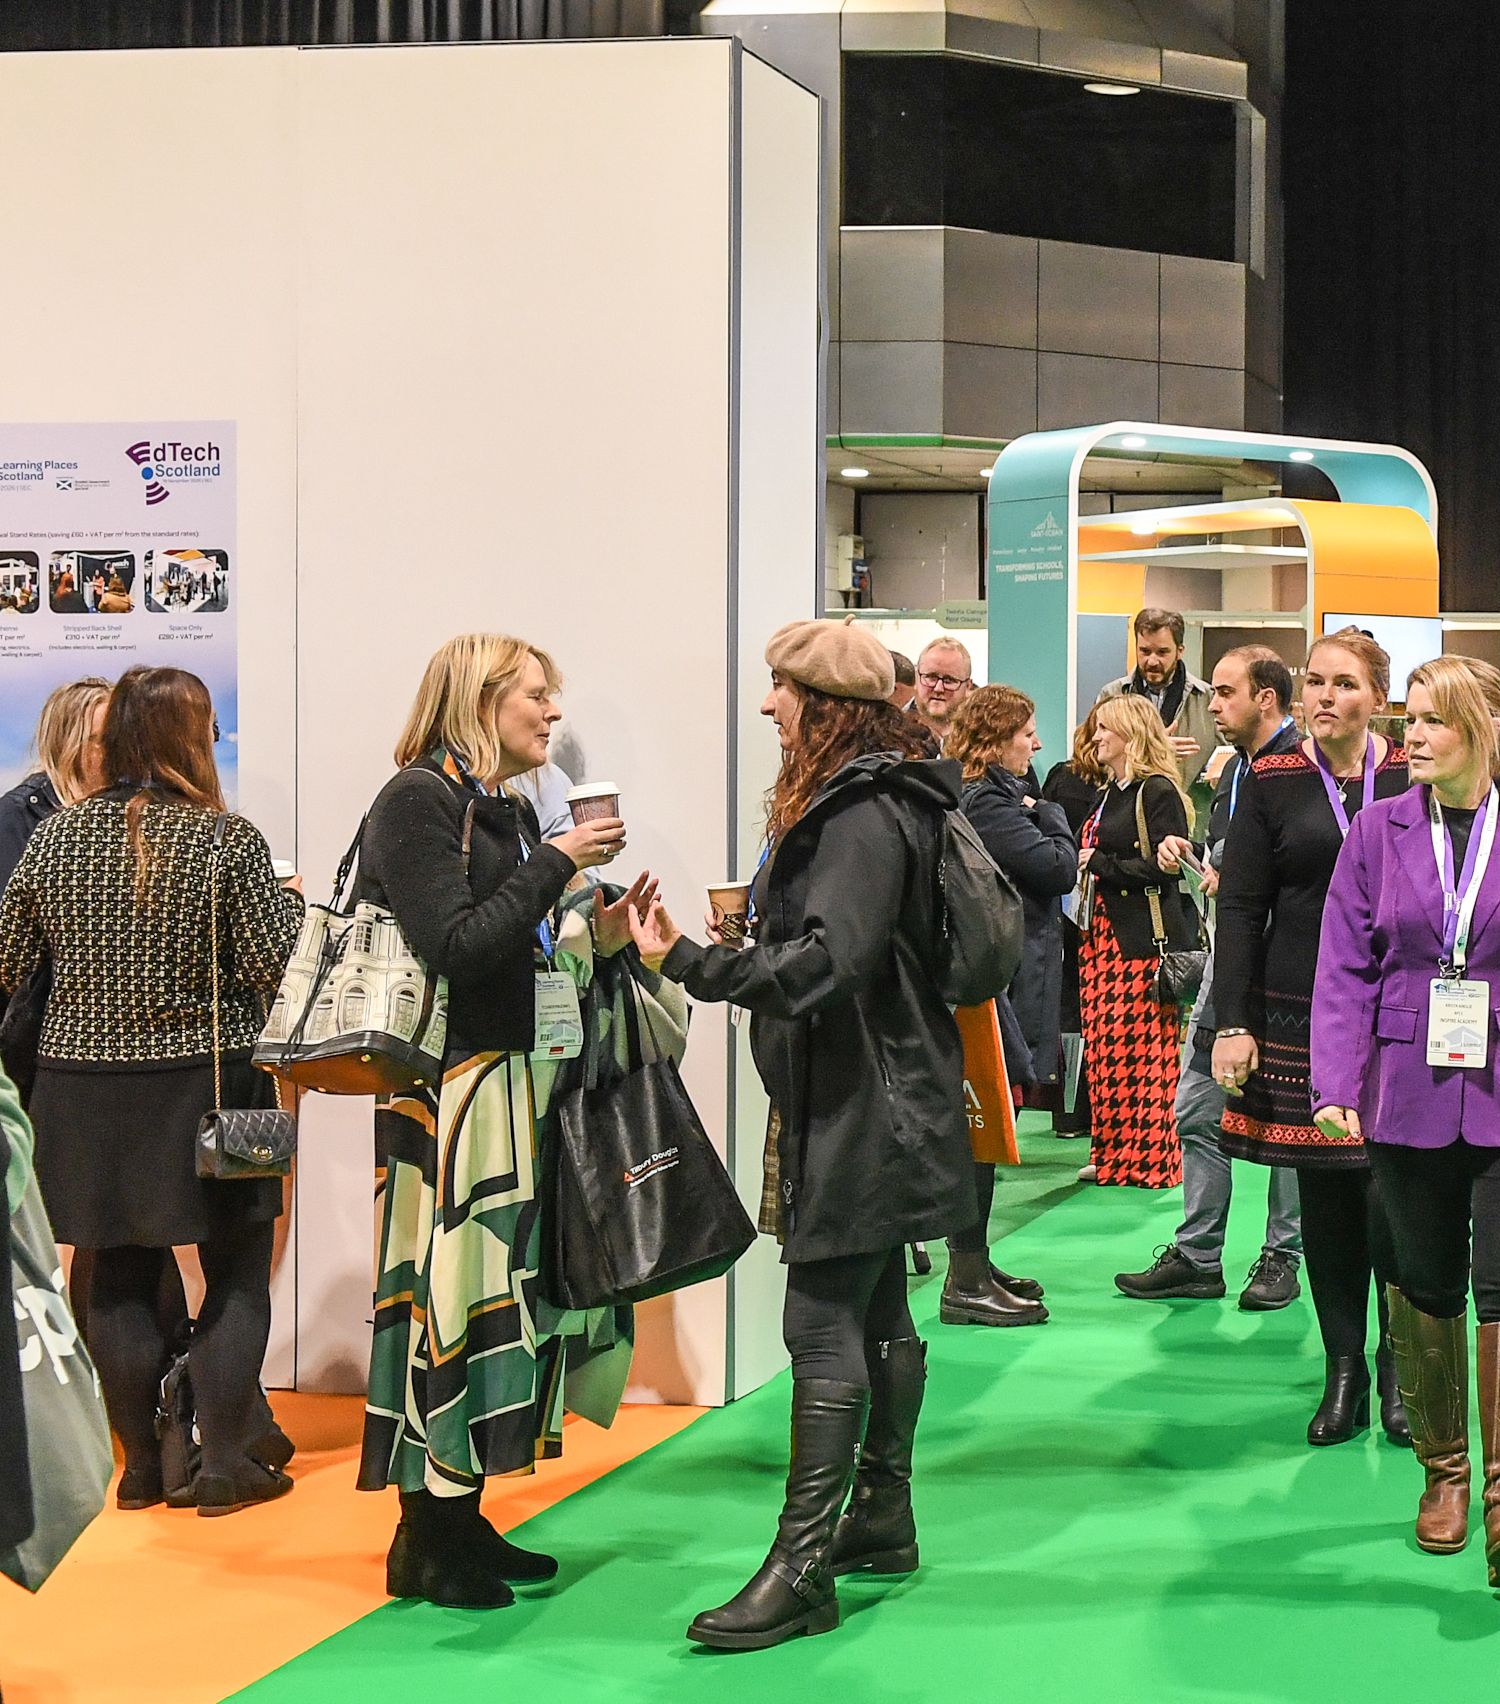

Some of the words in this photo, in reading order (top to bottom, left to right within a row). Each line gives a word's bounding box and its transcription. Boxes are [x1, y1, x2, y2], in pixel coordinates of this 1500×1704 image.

[45, 461, 78, 470] Places
[155, 463, 220, 478] Scotland
[0, 472, 44, 481] Scotland
